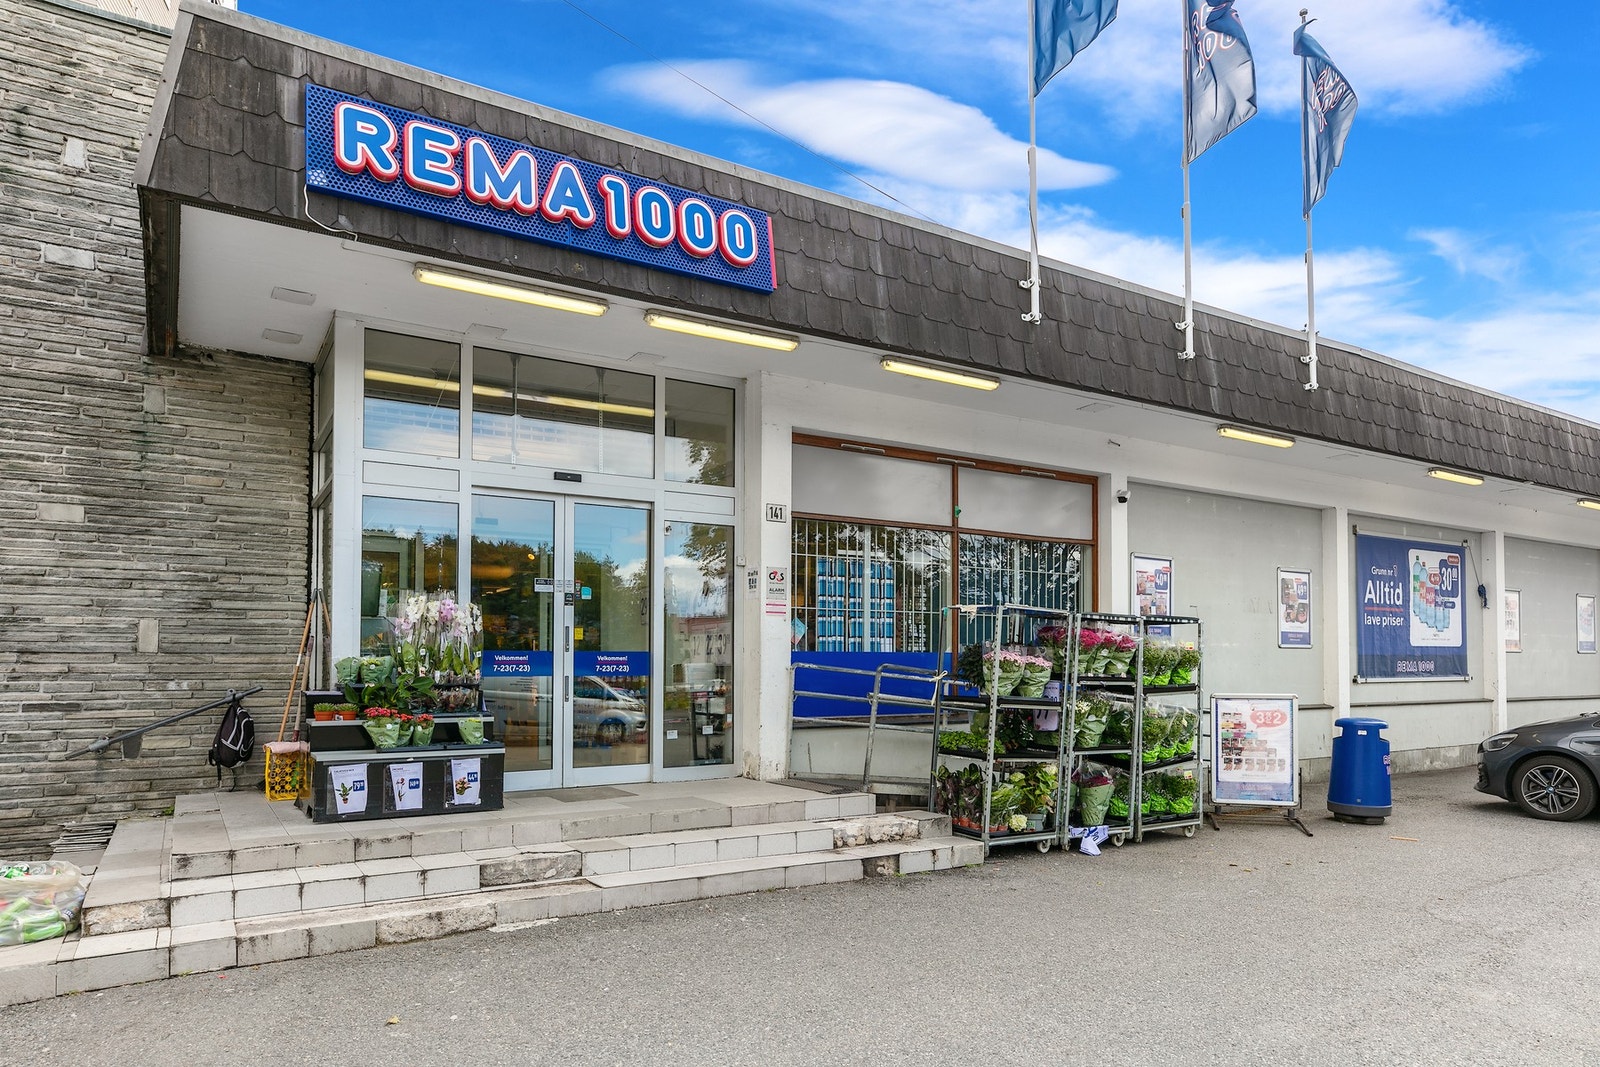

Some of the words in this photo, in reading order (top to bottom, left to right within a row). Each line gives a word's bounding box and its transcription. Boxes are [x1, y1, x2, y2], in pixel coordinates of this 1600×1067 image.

[334, 101, 596, 229] REMA
[598, 174, 759, 269] 1000
[769, 506, 783, 520] 141
[1371, 566, 1387, 576] Grunn
[1364, 579, 1403, 606] Alltid
[1364, 613, 1381, 626] lave
[1382, 613, 1404, 628] priser
[493, 664, 531, 673] 7-23(7-23)
[595, 665, 630, 673] 7-23(7-23)
[1396, 660, 1418, 672] REMA
[1418, 660, 1435, 672] 1000
[1256, 711, 1265, 725] 3
[1273, 712, 1282, 725] 2
